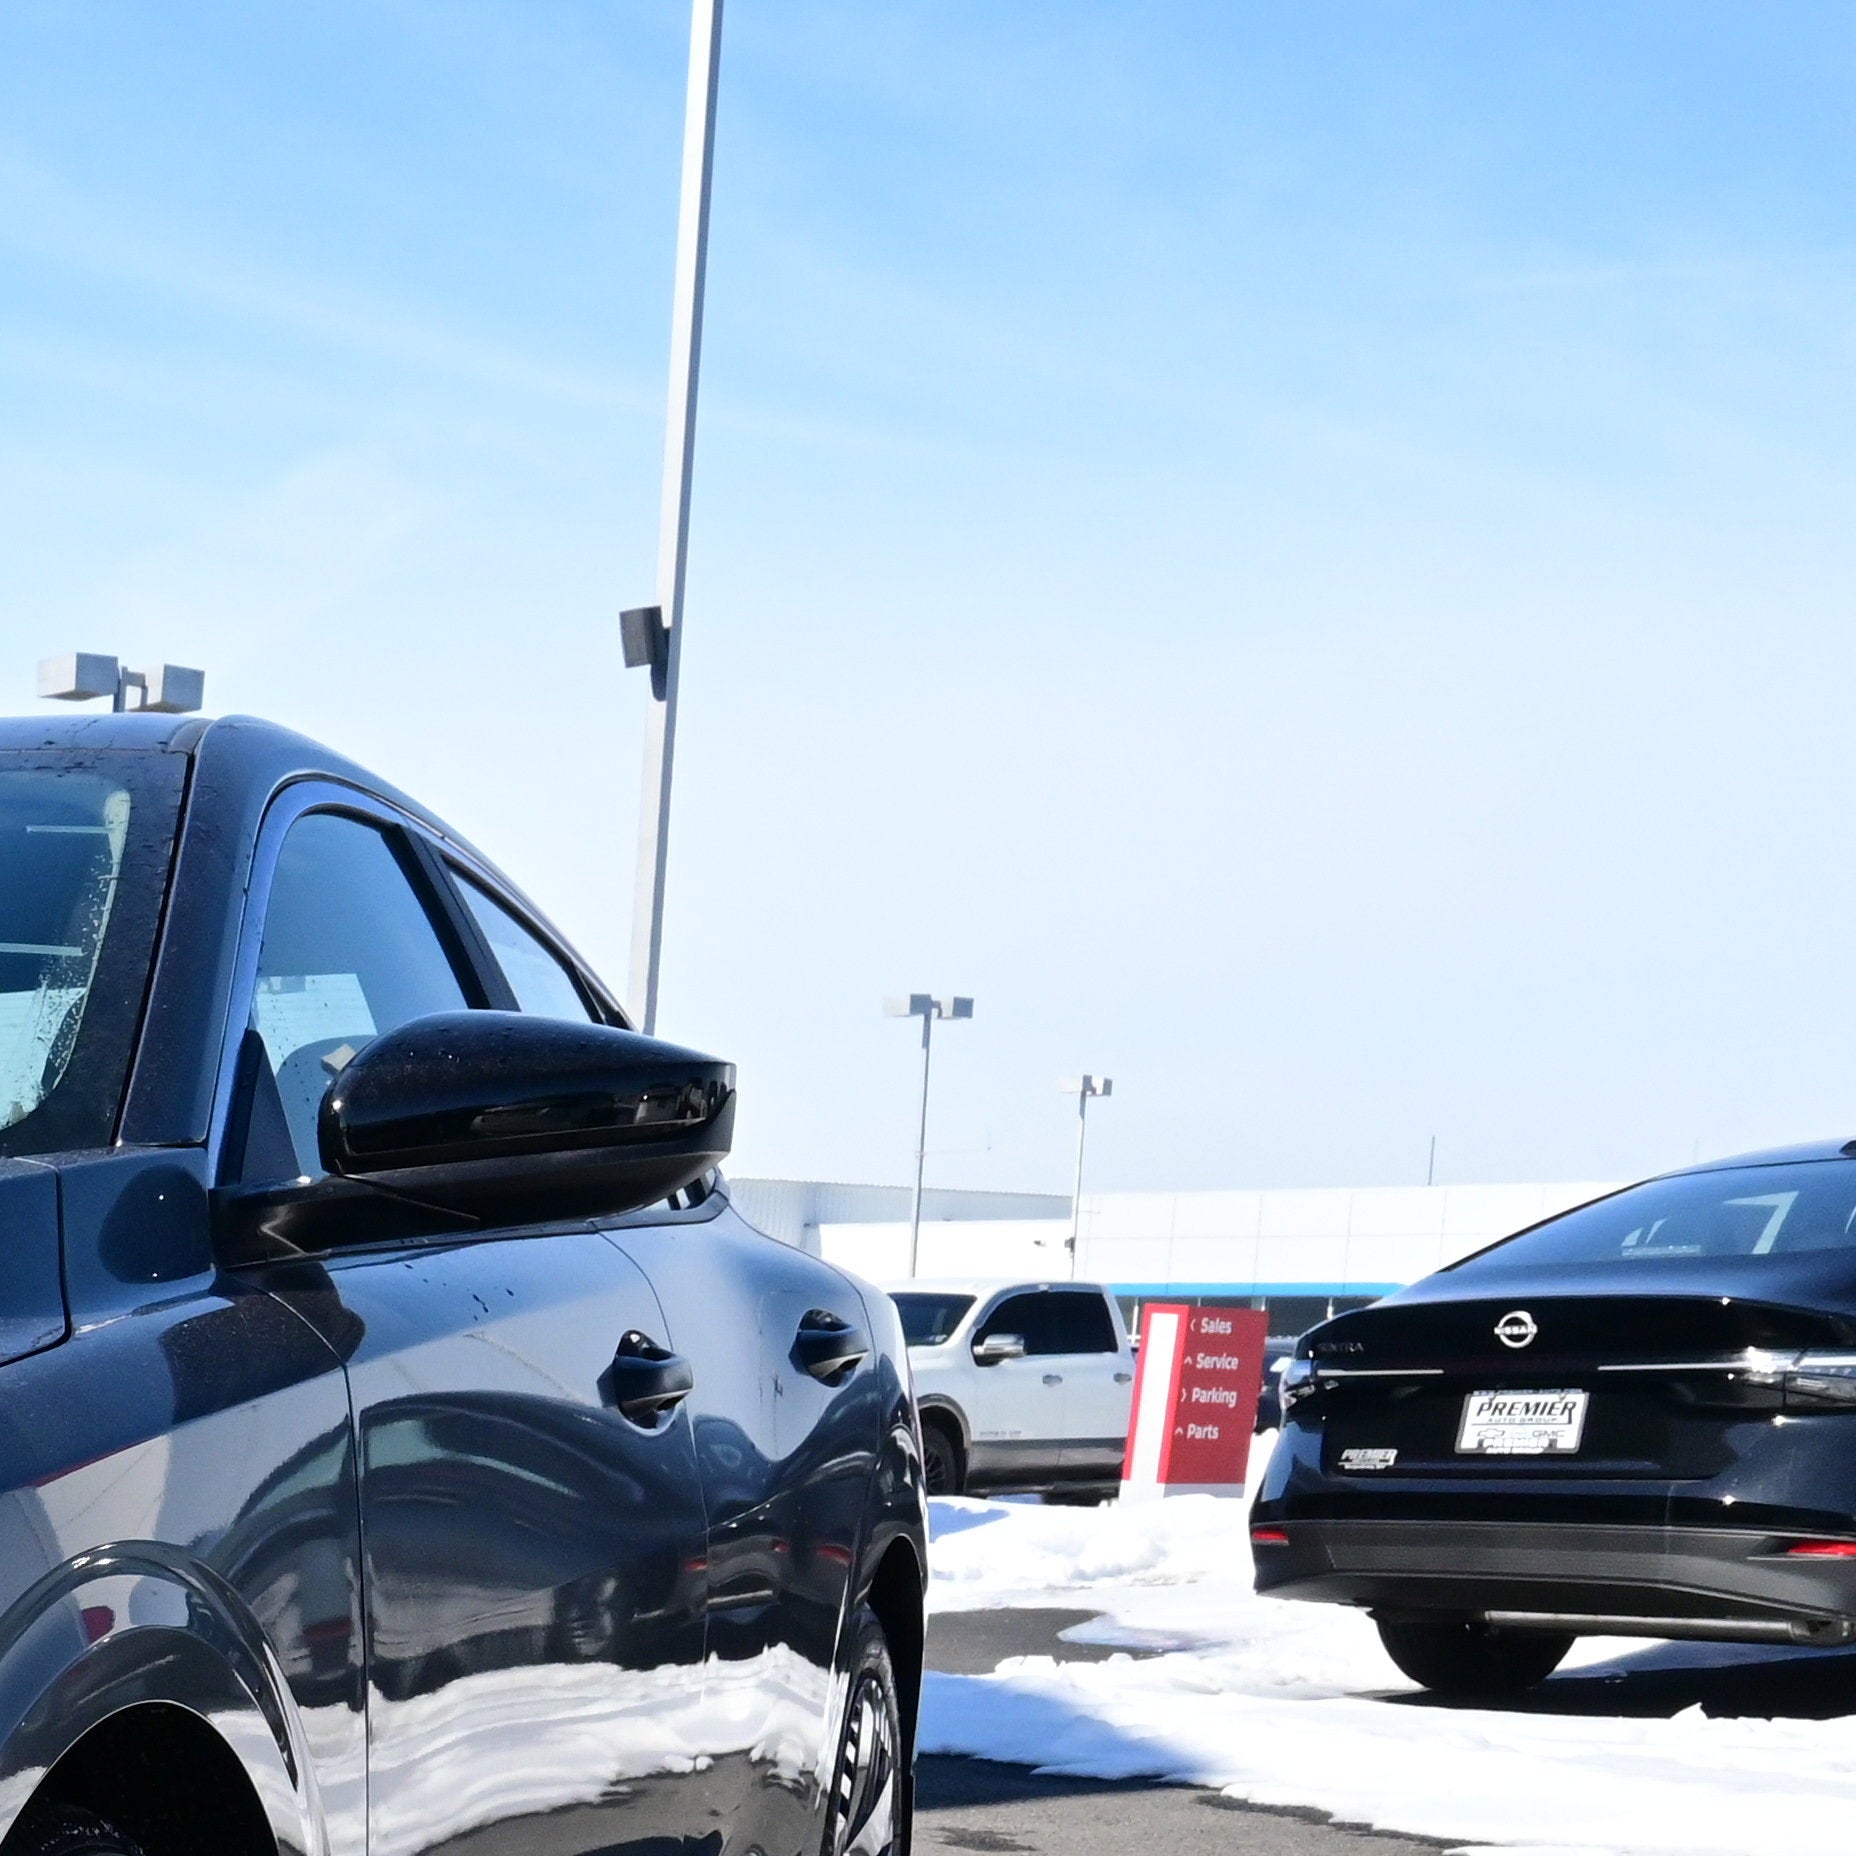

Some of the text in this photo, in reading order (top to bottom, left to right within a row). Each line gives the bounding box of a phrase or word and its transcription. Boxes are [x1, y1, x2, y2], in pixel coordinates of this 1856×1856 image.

[1200, 1317, 1232, 1335] Sales
[1196, 1354, 1238, 1371] Service
[1191, 1387, 1237, 1407] Parking
[1476, 1401, 1578, 1423] PREMIER
[1187, 1423, 1219, 1440] Parts
[1532, 1430, 1567, 1438] GMC
[1341, 1448, 1398, 1464] PREMIER
